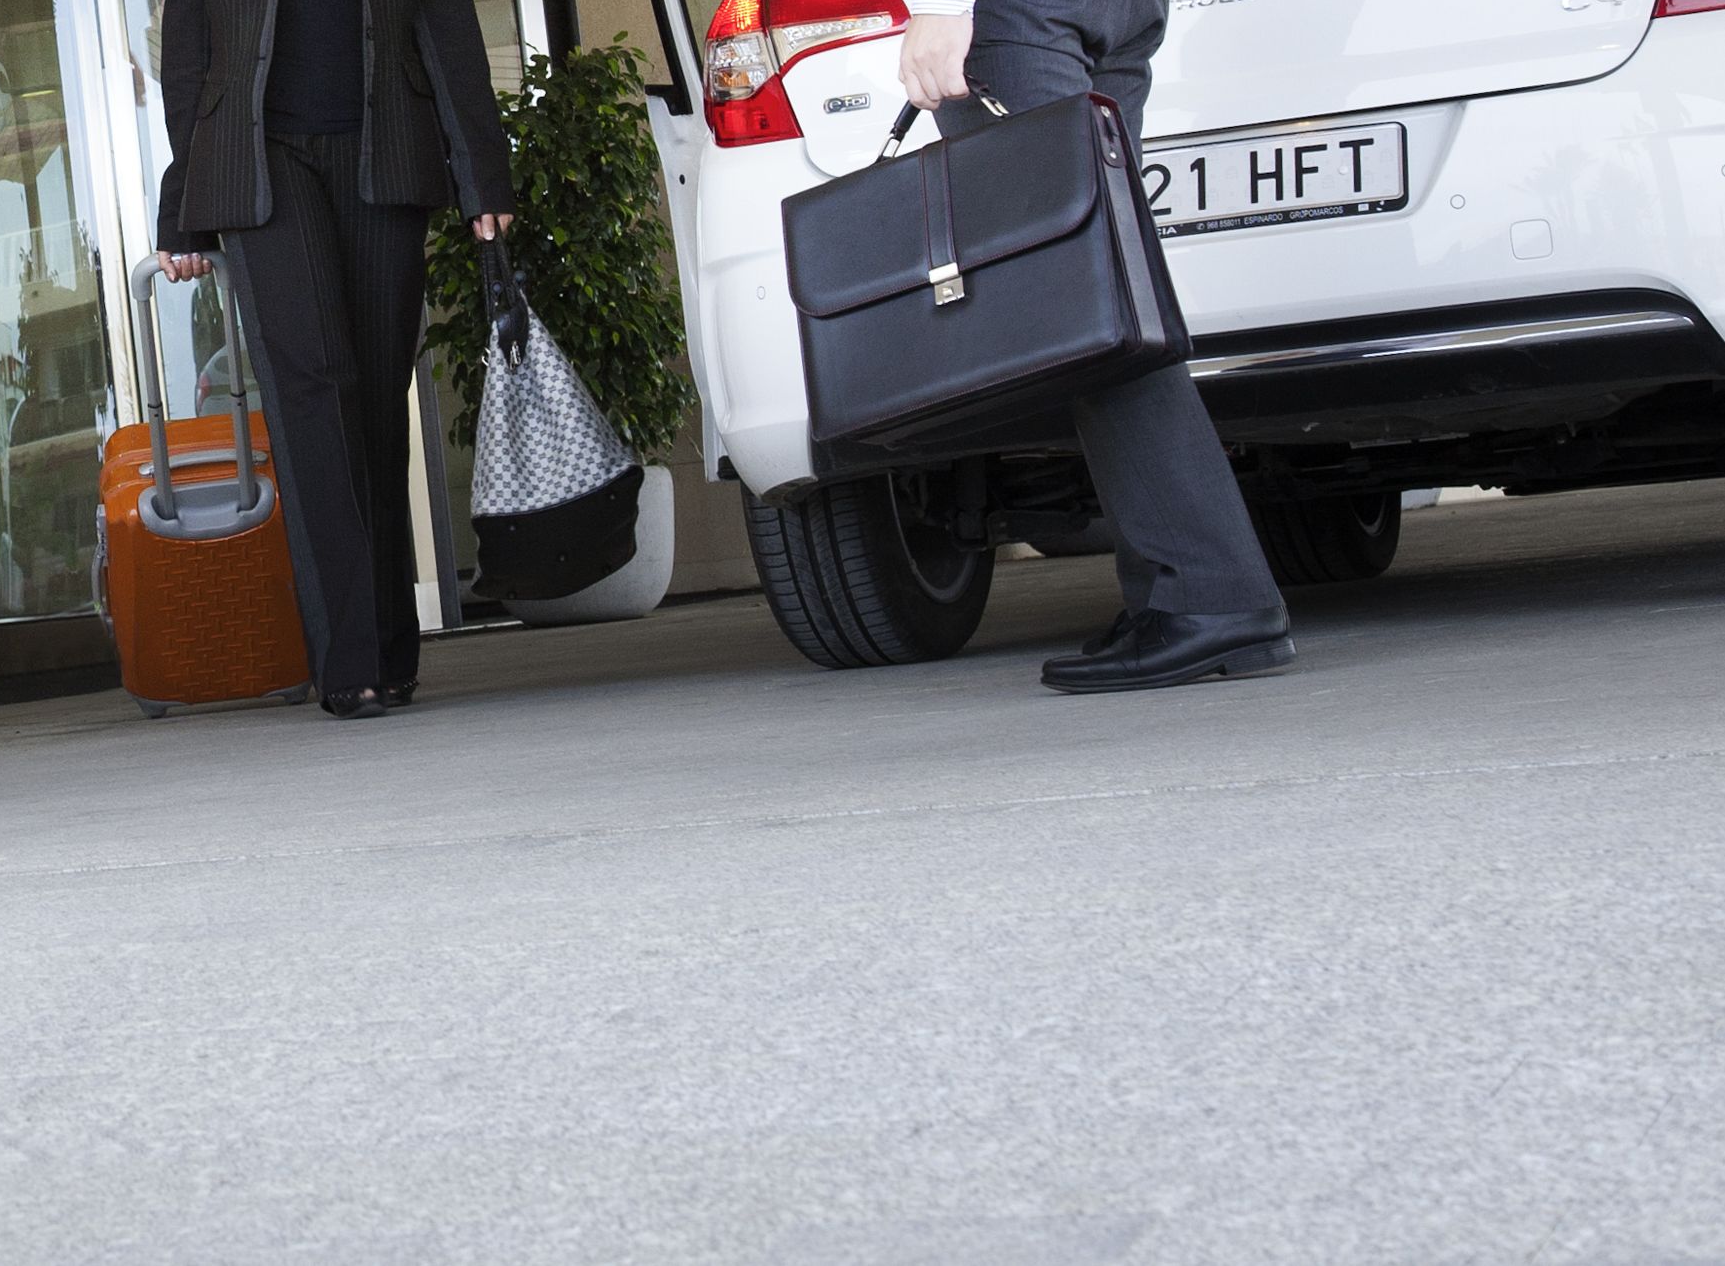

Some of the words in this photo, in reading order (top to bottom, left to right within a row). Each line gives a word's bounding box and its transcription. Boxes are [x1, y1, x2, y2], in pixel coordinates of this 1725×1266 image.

[1142, 157, 1207, 216] 21
[1250, 138, 1374, 204] HFT
[1244, 212, 1283, 225] ESPINARDO
